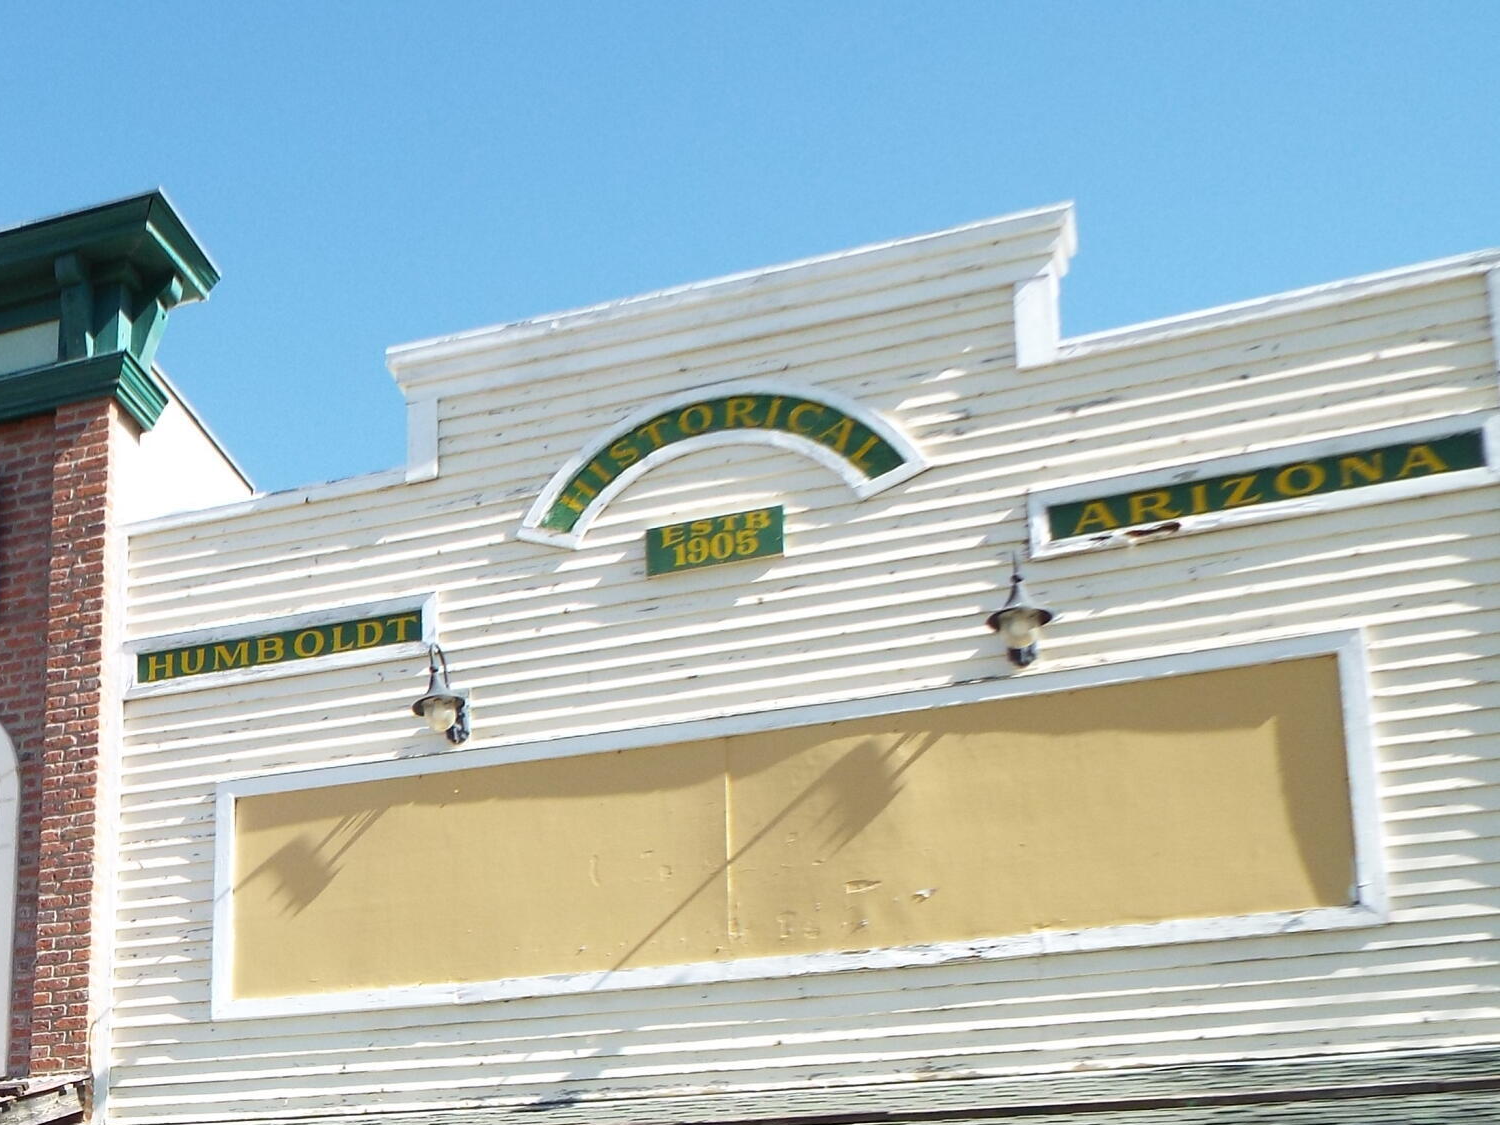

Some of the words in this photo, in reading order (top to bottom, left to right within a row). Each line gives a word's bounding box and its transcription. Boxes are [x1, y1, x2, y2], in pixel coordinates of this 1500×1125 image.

[560, 396, 883, 514] HISTORICAL
[1071, 443, 1449, 536] ARIZONA
[660, 509, 772, 549] ESTB
[672, 528, 760, 568] 1905
[146, 614, 419, 682] HUMBOLDT
